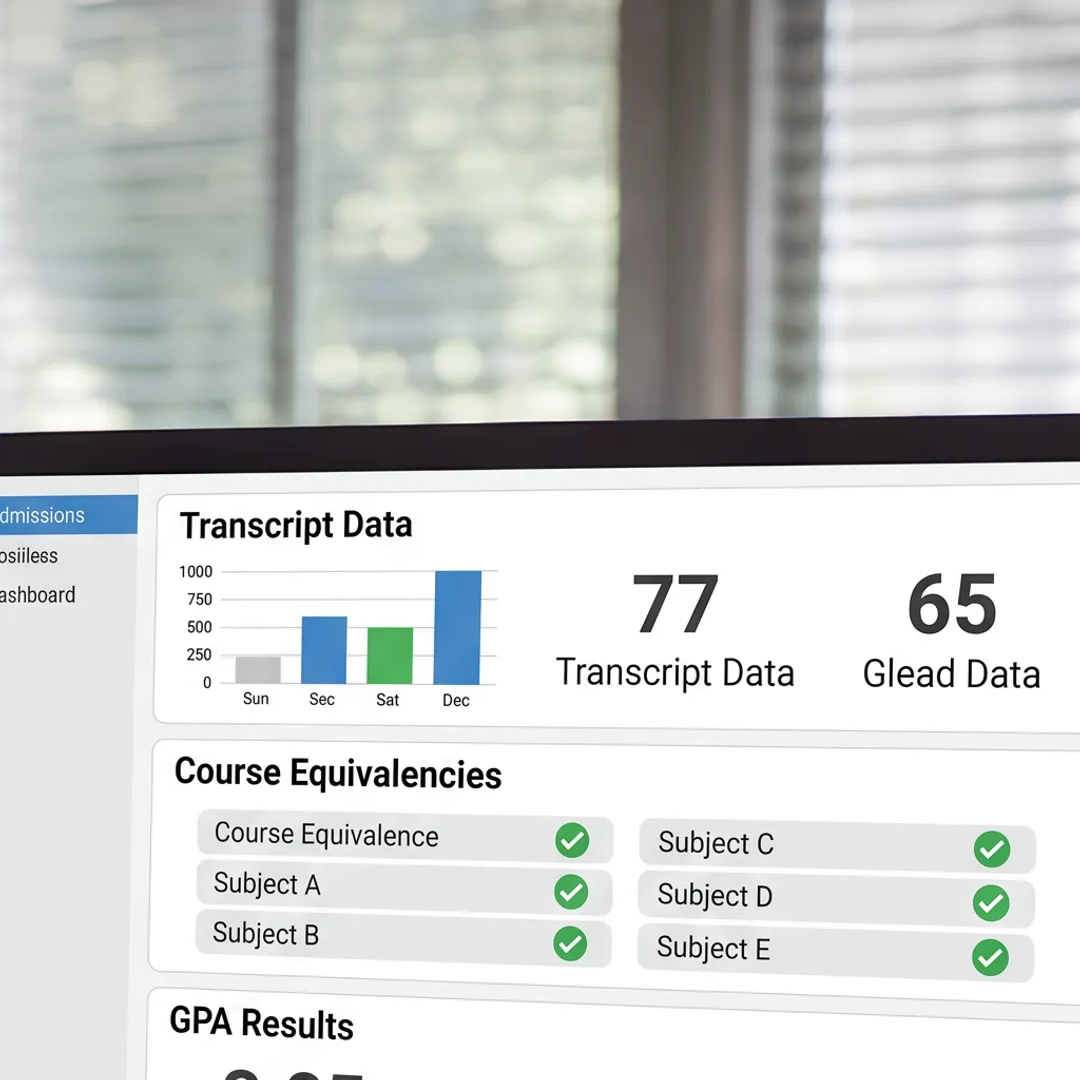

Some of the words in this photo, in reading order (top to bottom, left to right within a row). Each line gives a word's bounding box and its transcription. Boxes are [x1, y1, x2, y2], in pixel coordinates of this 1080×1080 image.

[180, 510, 334, 545] Transcript
[344, 510, 412, 538] Data
[180, 565, 212, 578] 1000
[188, 593, 212, 605] 750
[633, 574, 718, 633] 77
[909, 573, 996, 635] 65
[188, 620, 212, 633] 500
[187, 648, 212, 661] 250
[203, 676, 211, 689] 0
[556, 657, 712, 694] Transcript
[724, 658, 794, 686] Data
[864, 657, 954, 688] Glead
[968, 659, 1040, 688] Data
[243, 692, 269, 705] Sun
[309, 692, 335, 705] Sec
[377, 693, 399, 706] Sat
[443, 693, 470, 707] Dec
[175, 756, 281, 785] Course
[291, 758, 502, 793] Equivalencies
[215, 821, 294, 844] Course
[302, 823, 438, 850] Equivalence
[659, 830, 749, 859] Subject
[758, 833, 774, 855] C
[214, 871, 298, 899] Subject
[305, 874, 321, 895] A
[658, 882, 748, 912] Subject
[757, 885, 772, 907] D
[213, 921, 297, 949] Subject
[305, 924, 318, 945] B
[657, 935, 747, 964] Subject
[757, 938, 770, 960] E
[170, 1005, 233, 1035] GPA
[242, 1008, 353, 1041] Results
